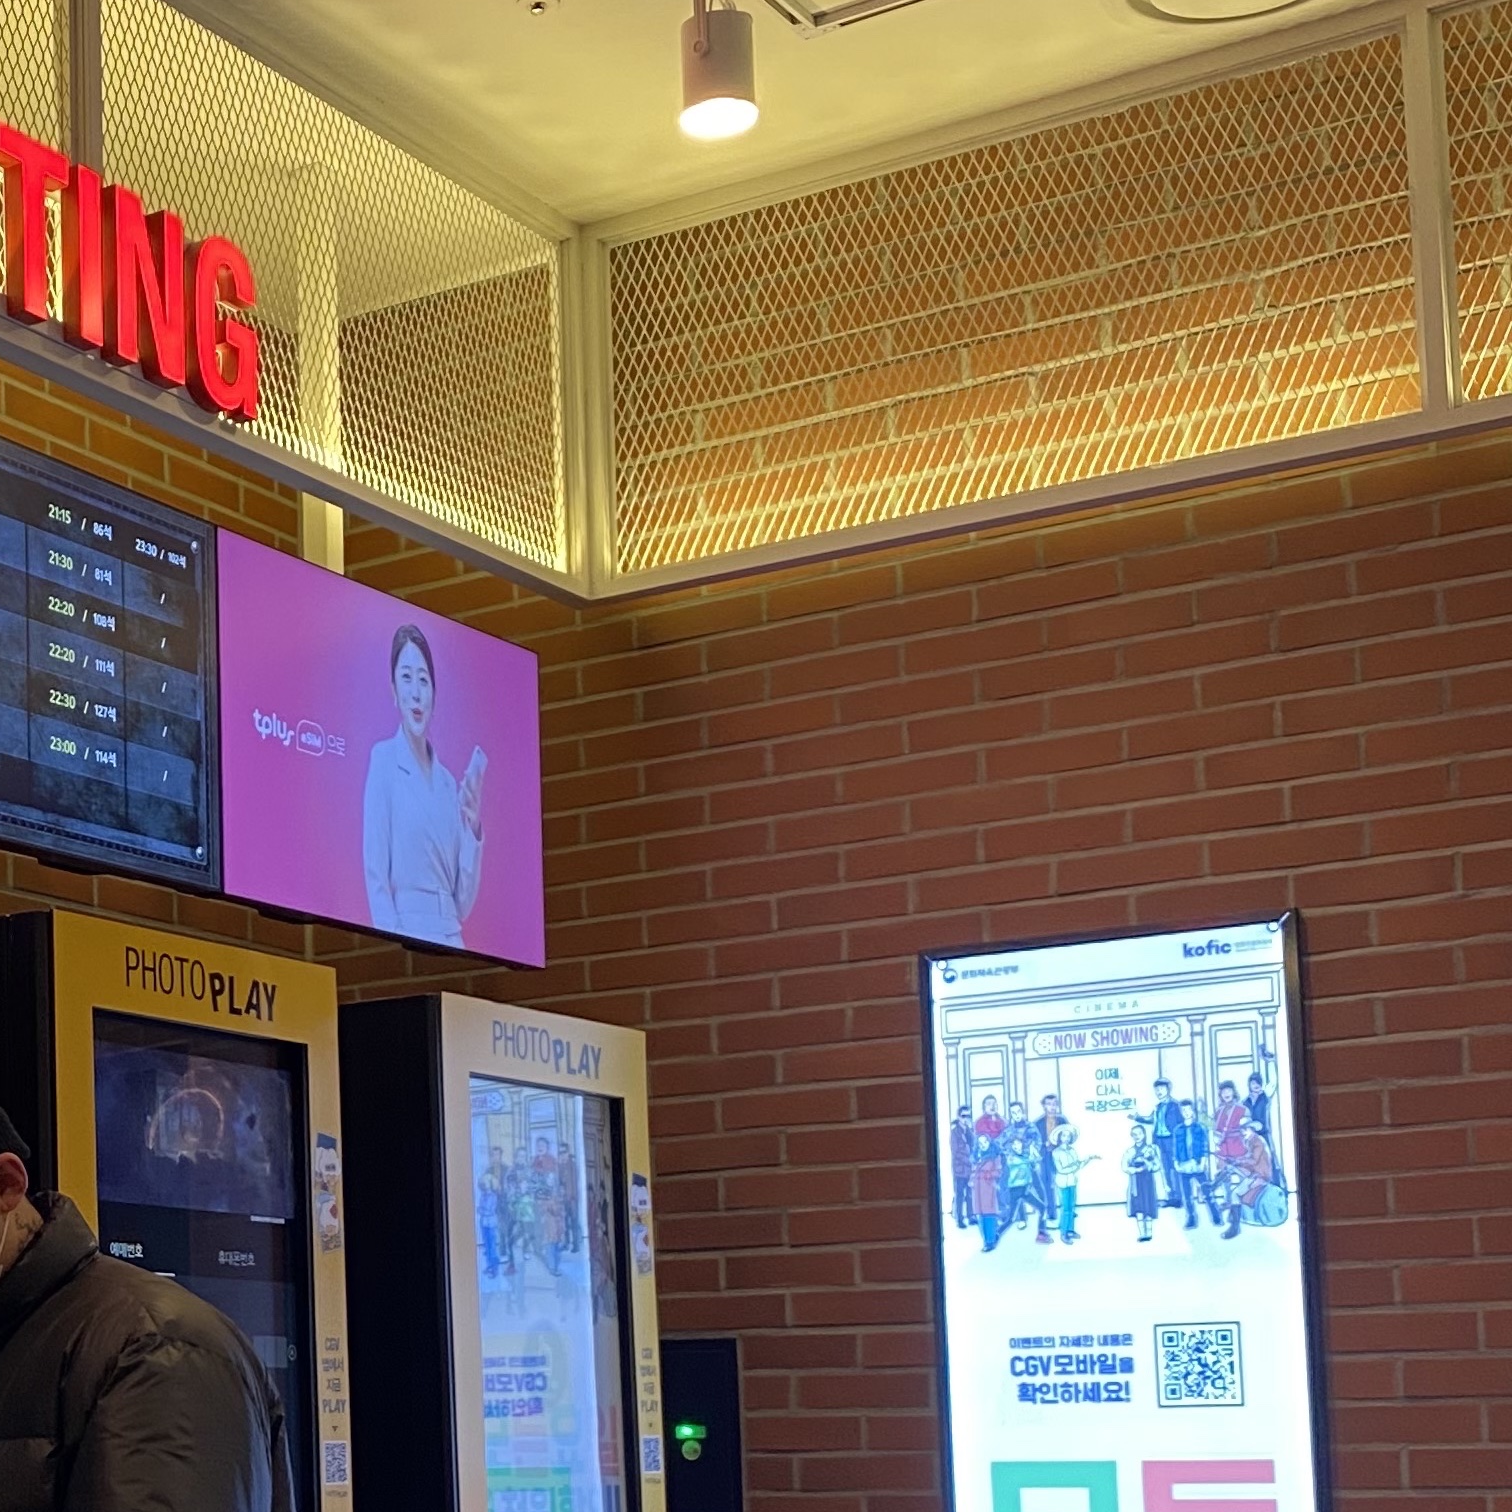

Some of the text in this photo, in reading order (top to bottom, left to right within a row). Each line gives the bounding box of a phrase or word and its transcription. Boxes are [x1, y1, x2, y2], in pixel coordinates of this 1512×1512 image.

[48, 503, 114, 542] 21:15 86석
[135, 537, 158, 559] 23:30
[48, 549, 74, 572] 21:30
[48, 595, 75, 618] 22:20
[49, 641, 76, 665] 22:20
[49, 688, 117, 723] 22:30 127석
[253, 708, 295, 746] tplus
[49, 734, 118, 769] 23:00 114석
[1182, 939, 1232, 960] kofic
[125, 945, 278, 1022] PHOTOPLAY
[1074, 1000, 1140, 1015] CINEMA
[1053, 1023, 1160, 1051] NOW SHOWING
[492, 1019, 603, 1080] PHOTOPLAY
[1008, 1336, 1056, 1350] 이벤트의
[1016, 1380, 1132, 1405] 확인하세요!
[322, 1398, 347, 1414] PLAY
